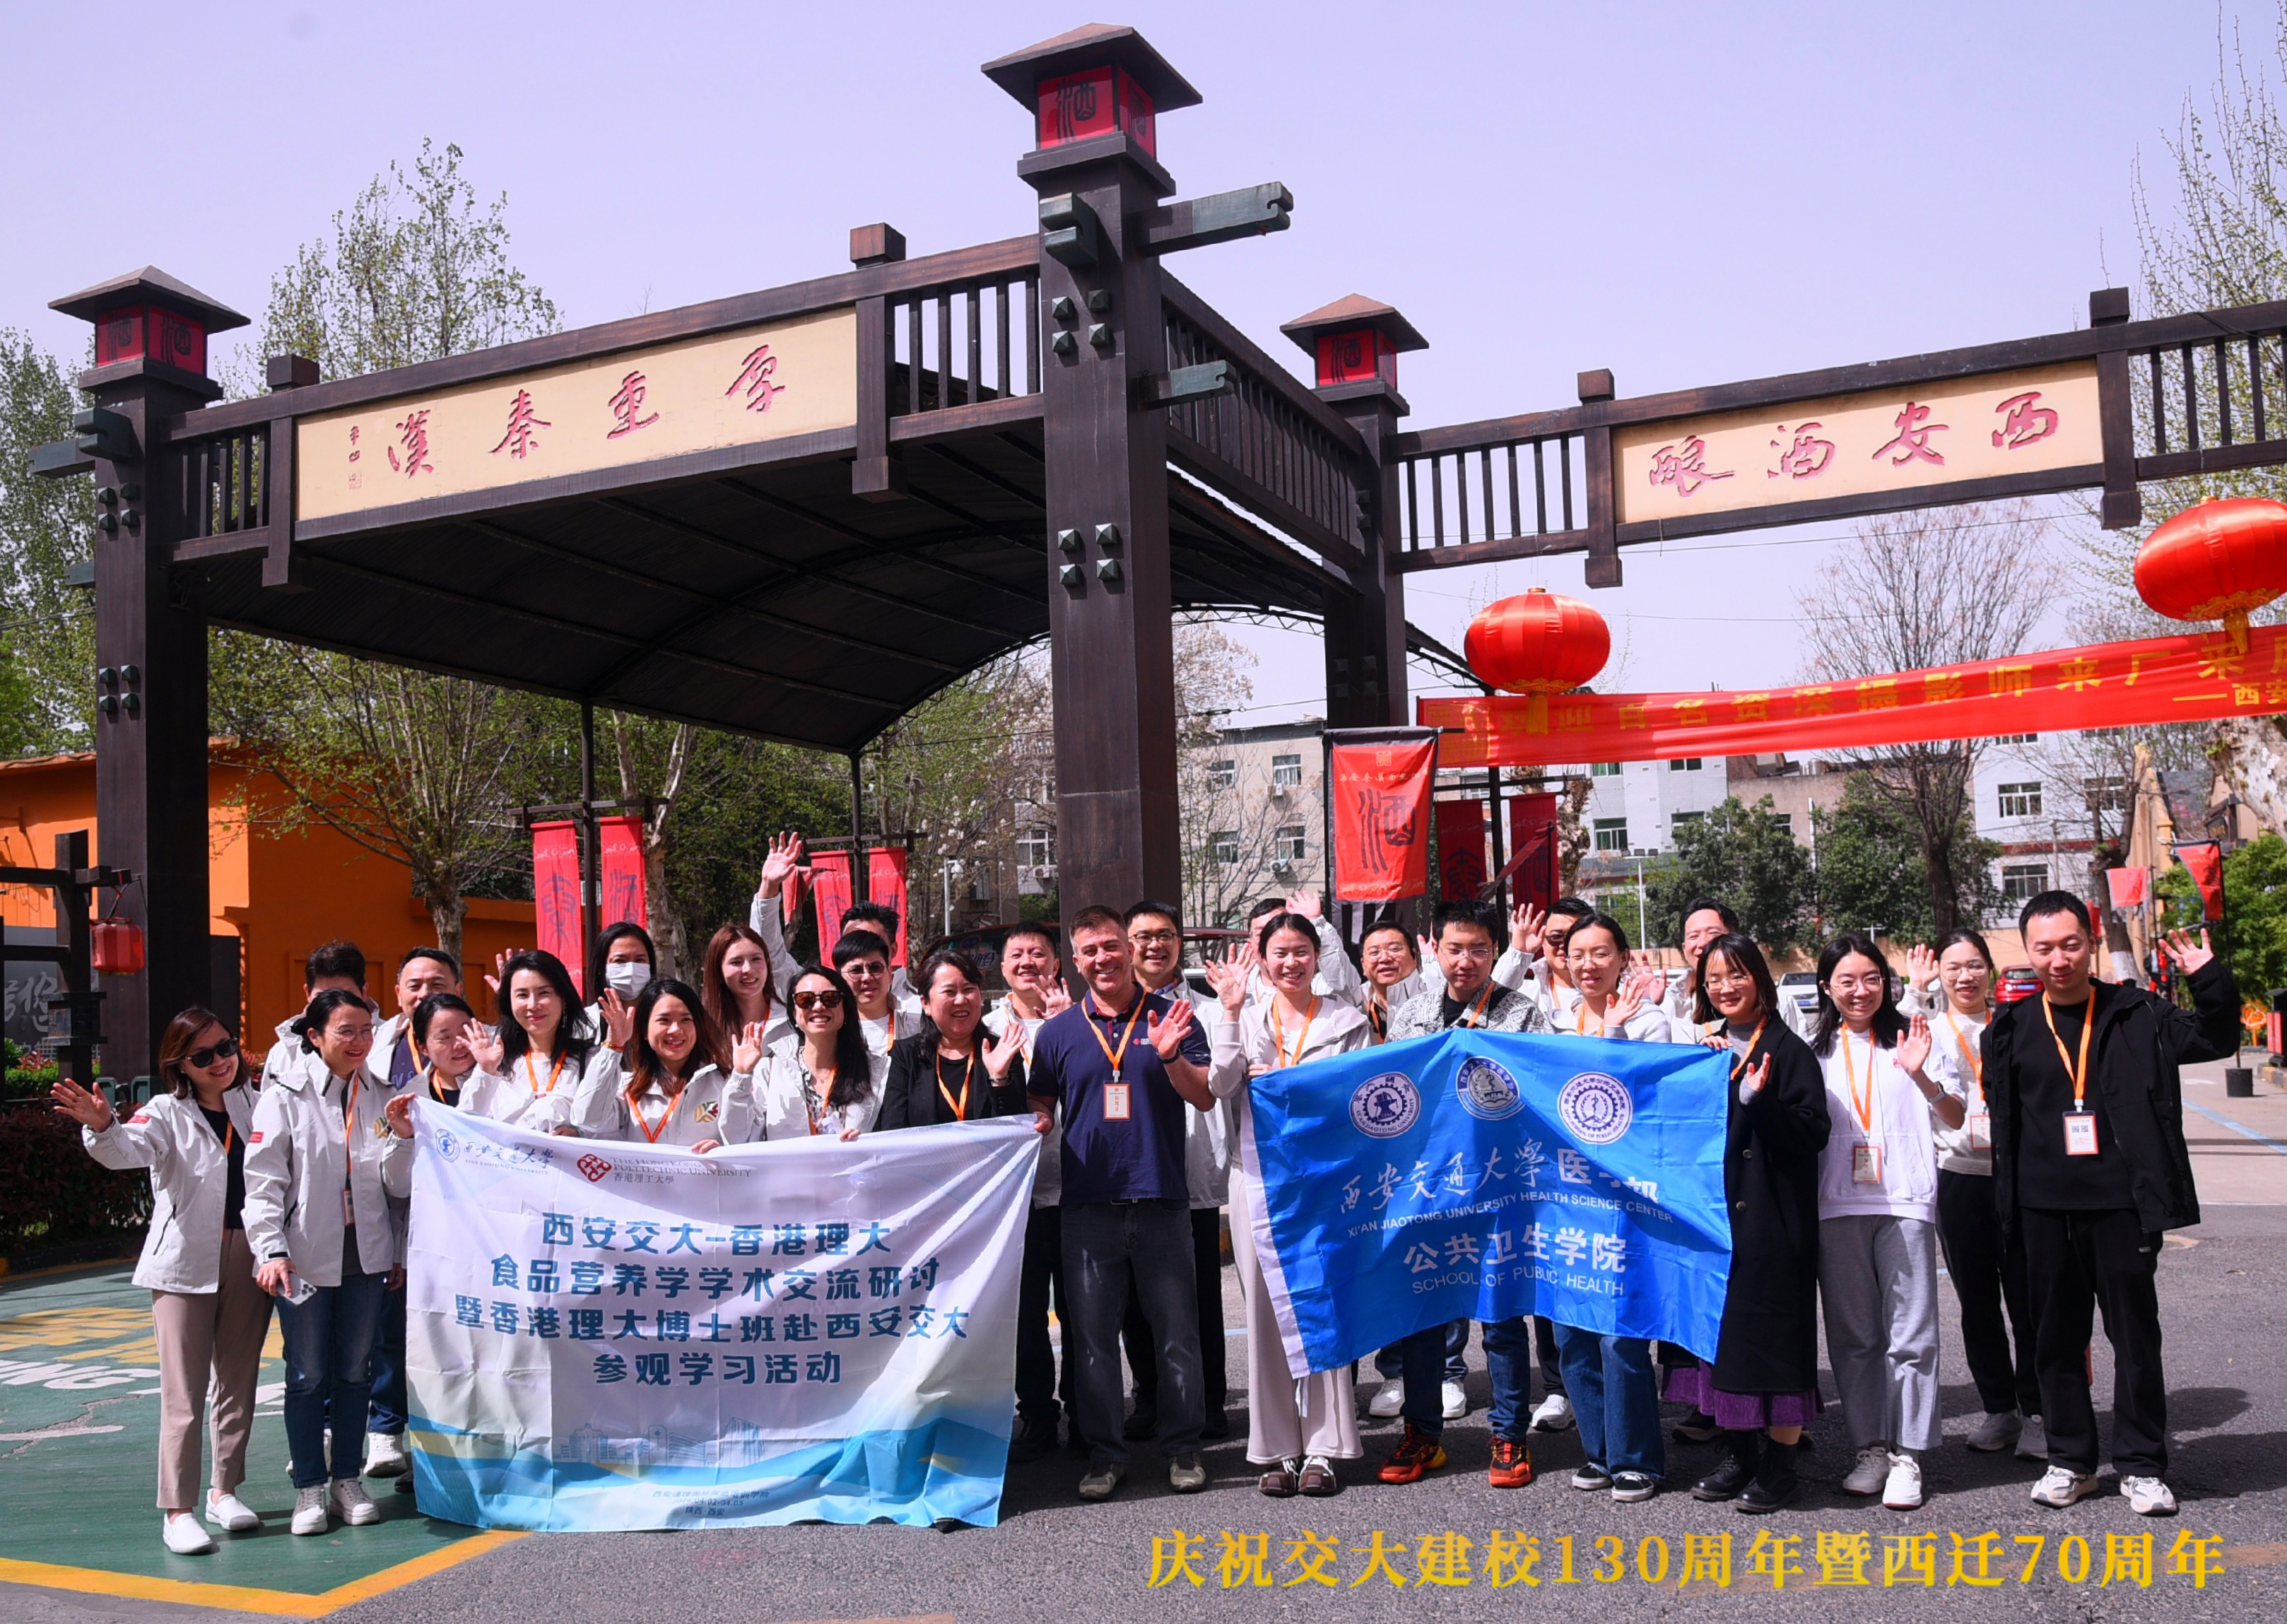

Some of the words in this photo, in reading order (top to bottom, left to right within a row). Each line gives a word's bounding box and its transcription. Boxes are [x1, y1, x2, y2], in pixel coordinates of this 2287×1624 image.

[614, 1164, 688, 1175] POLYTECHNIC
[690, 1167, 752, 1177] UNIVERSITY
[1348, 1220, 1378, 1238] XI'AN
[1380, 1211, 1443, 1230] JIAOTONG
[1446, 1193, 1517, 1218] UNIVERSITY
[1520, 1191, 1568, 1203] HEALTH
[1571, 1193, 1623, 1211] SCIENCE
[1626, 1201, 1674, 1223] CENTER
[1403, 1222, 1627, 1274] 公共卫生学院
[490, 1253, 940, 1302] 食品营养学学术交流研讨
[1412, 1271, 1479, 1295] SCHOOL
[1485, 1273, 1506, 1288] OF
[1512, 1266, 1558, 1285] PUBLIC
[1566, 1273, 1624, 1296] HEALTH
[455, 1293, 970, 1343] 暨香港理大博士班赴西安交大
[592, 1351, 842, 1387] 参观学习活动
